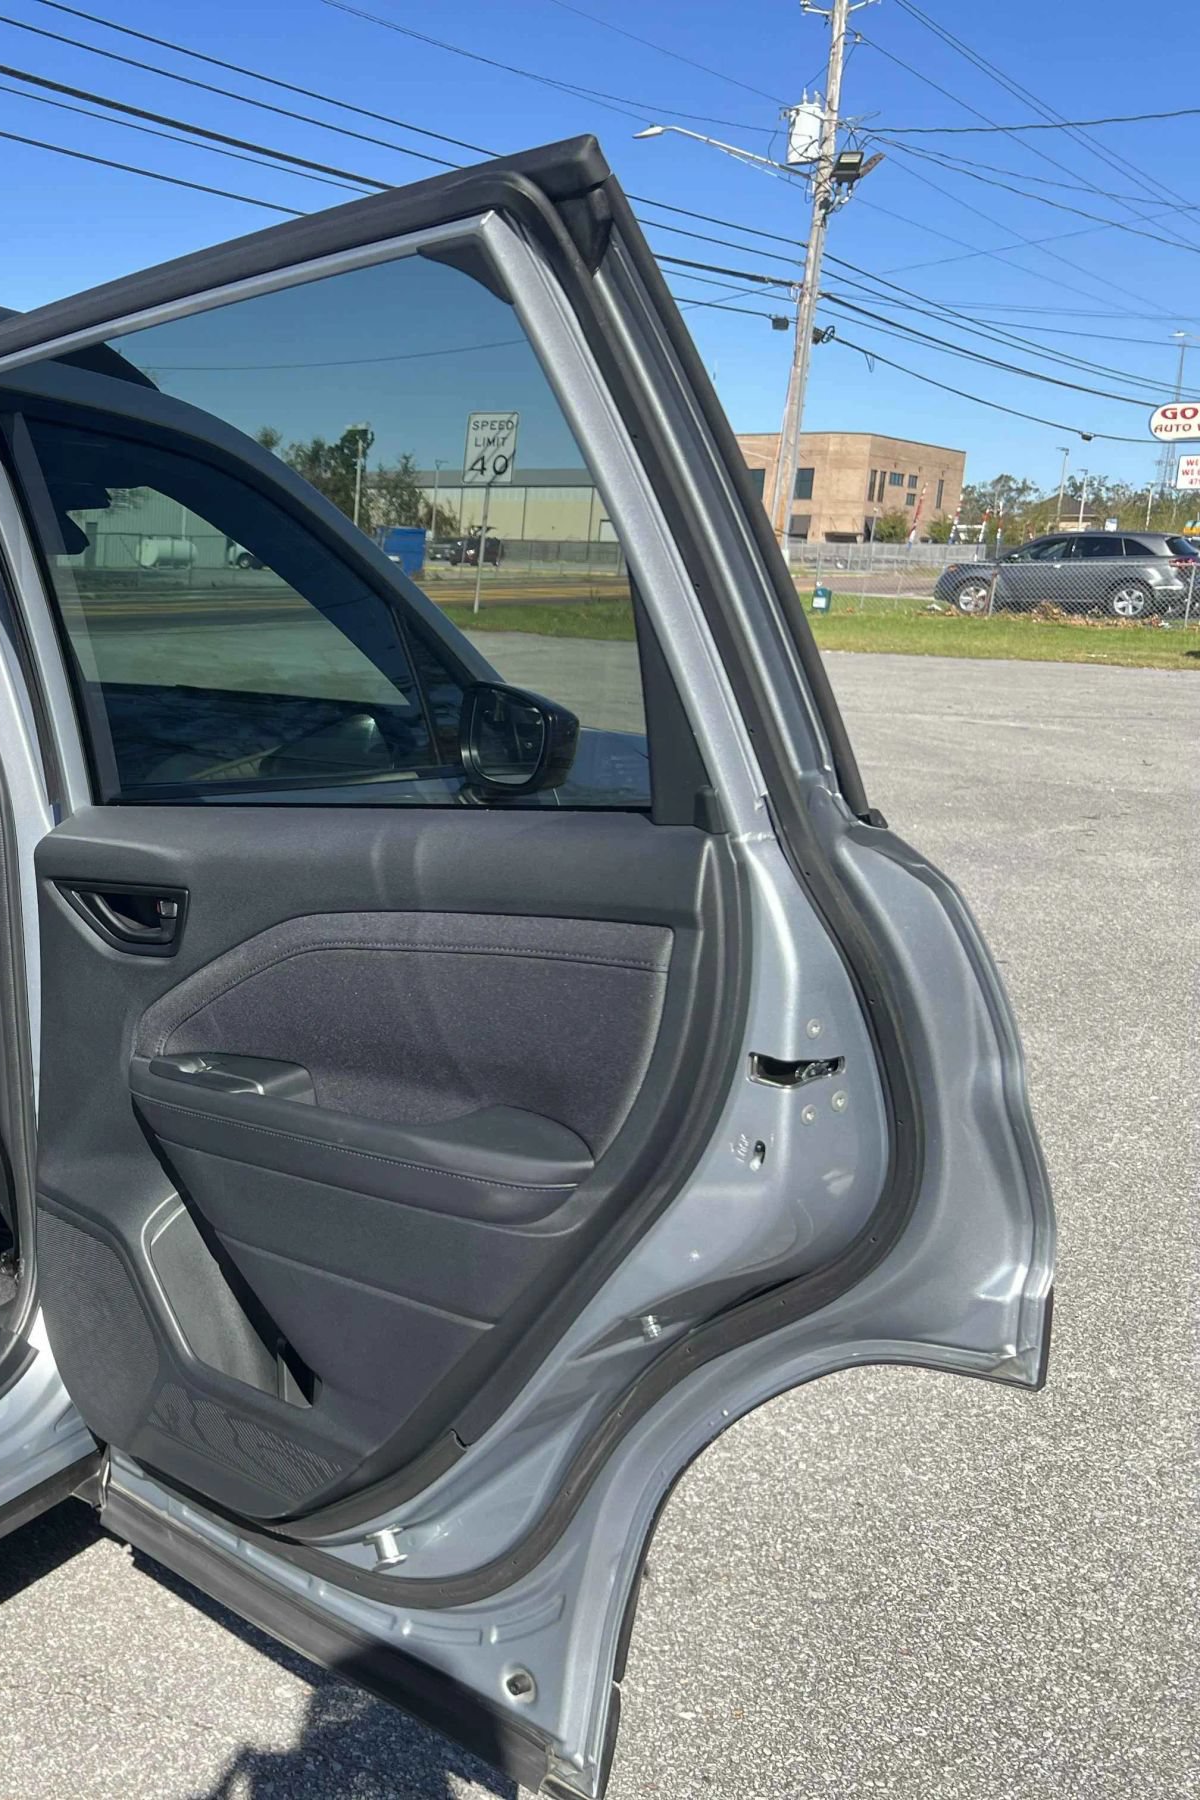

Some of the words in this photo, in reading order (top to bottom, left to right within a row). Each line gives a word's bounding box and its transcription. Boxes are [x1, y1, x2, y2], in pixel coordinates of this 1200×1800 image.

[471, 419, 515, 431] SPEED
[1154, 424, 1192, 433] AUTO
[474, 436, 508, 448] LIMIT
[468, 454, 509, 476] 40
